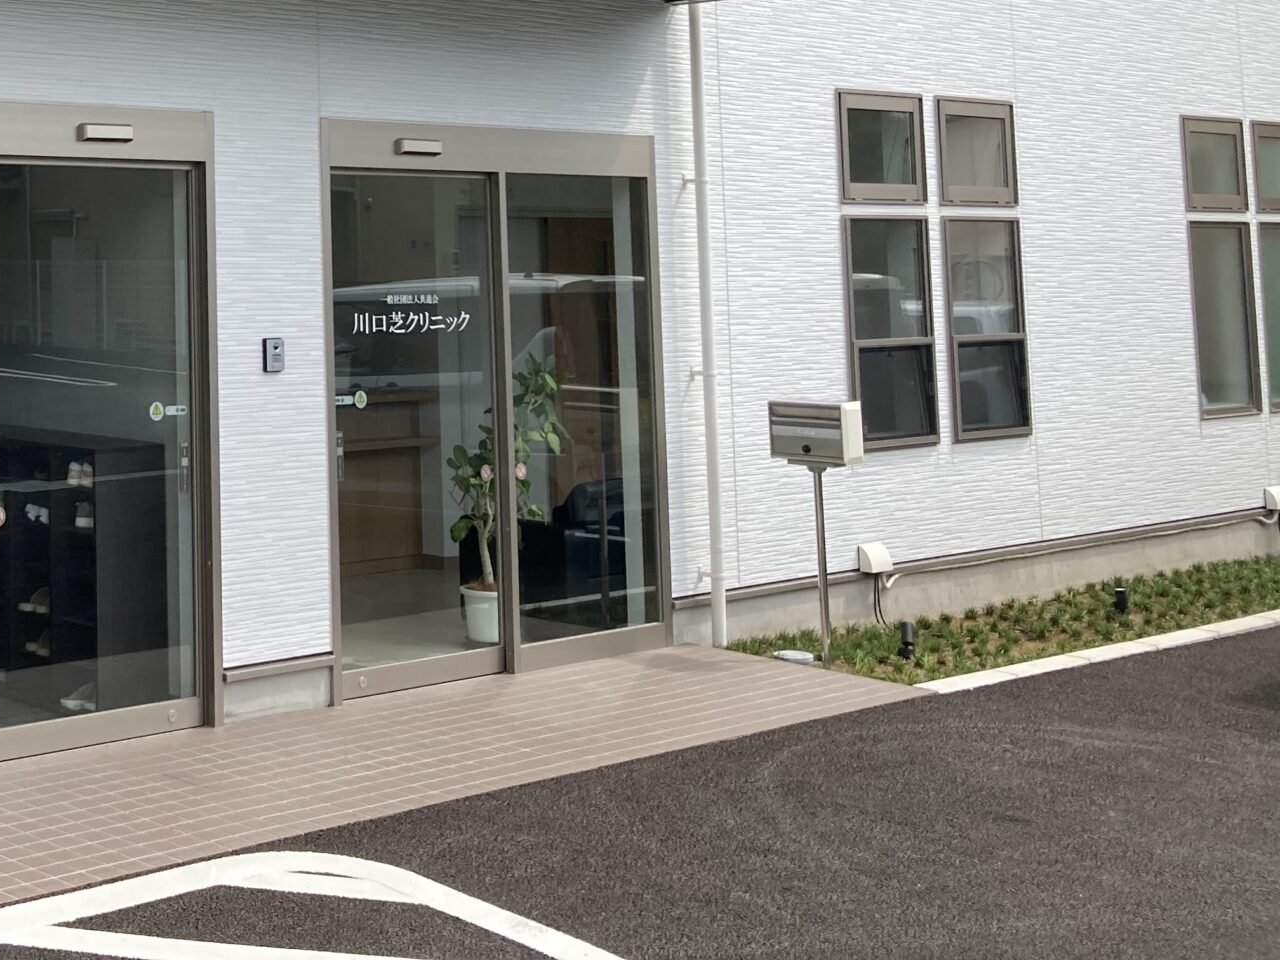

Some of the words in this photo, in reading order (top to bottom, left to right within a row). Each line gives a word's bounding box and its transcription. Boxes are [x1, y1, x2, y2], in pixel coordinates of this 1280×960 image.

[352, 310, 471, 335] 川口芝クリニック
